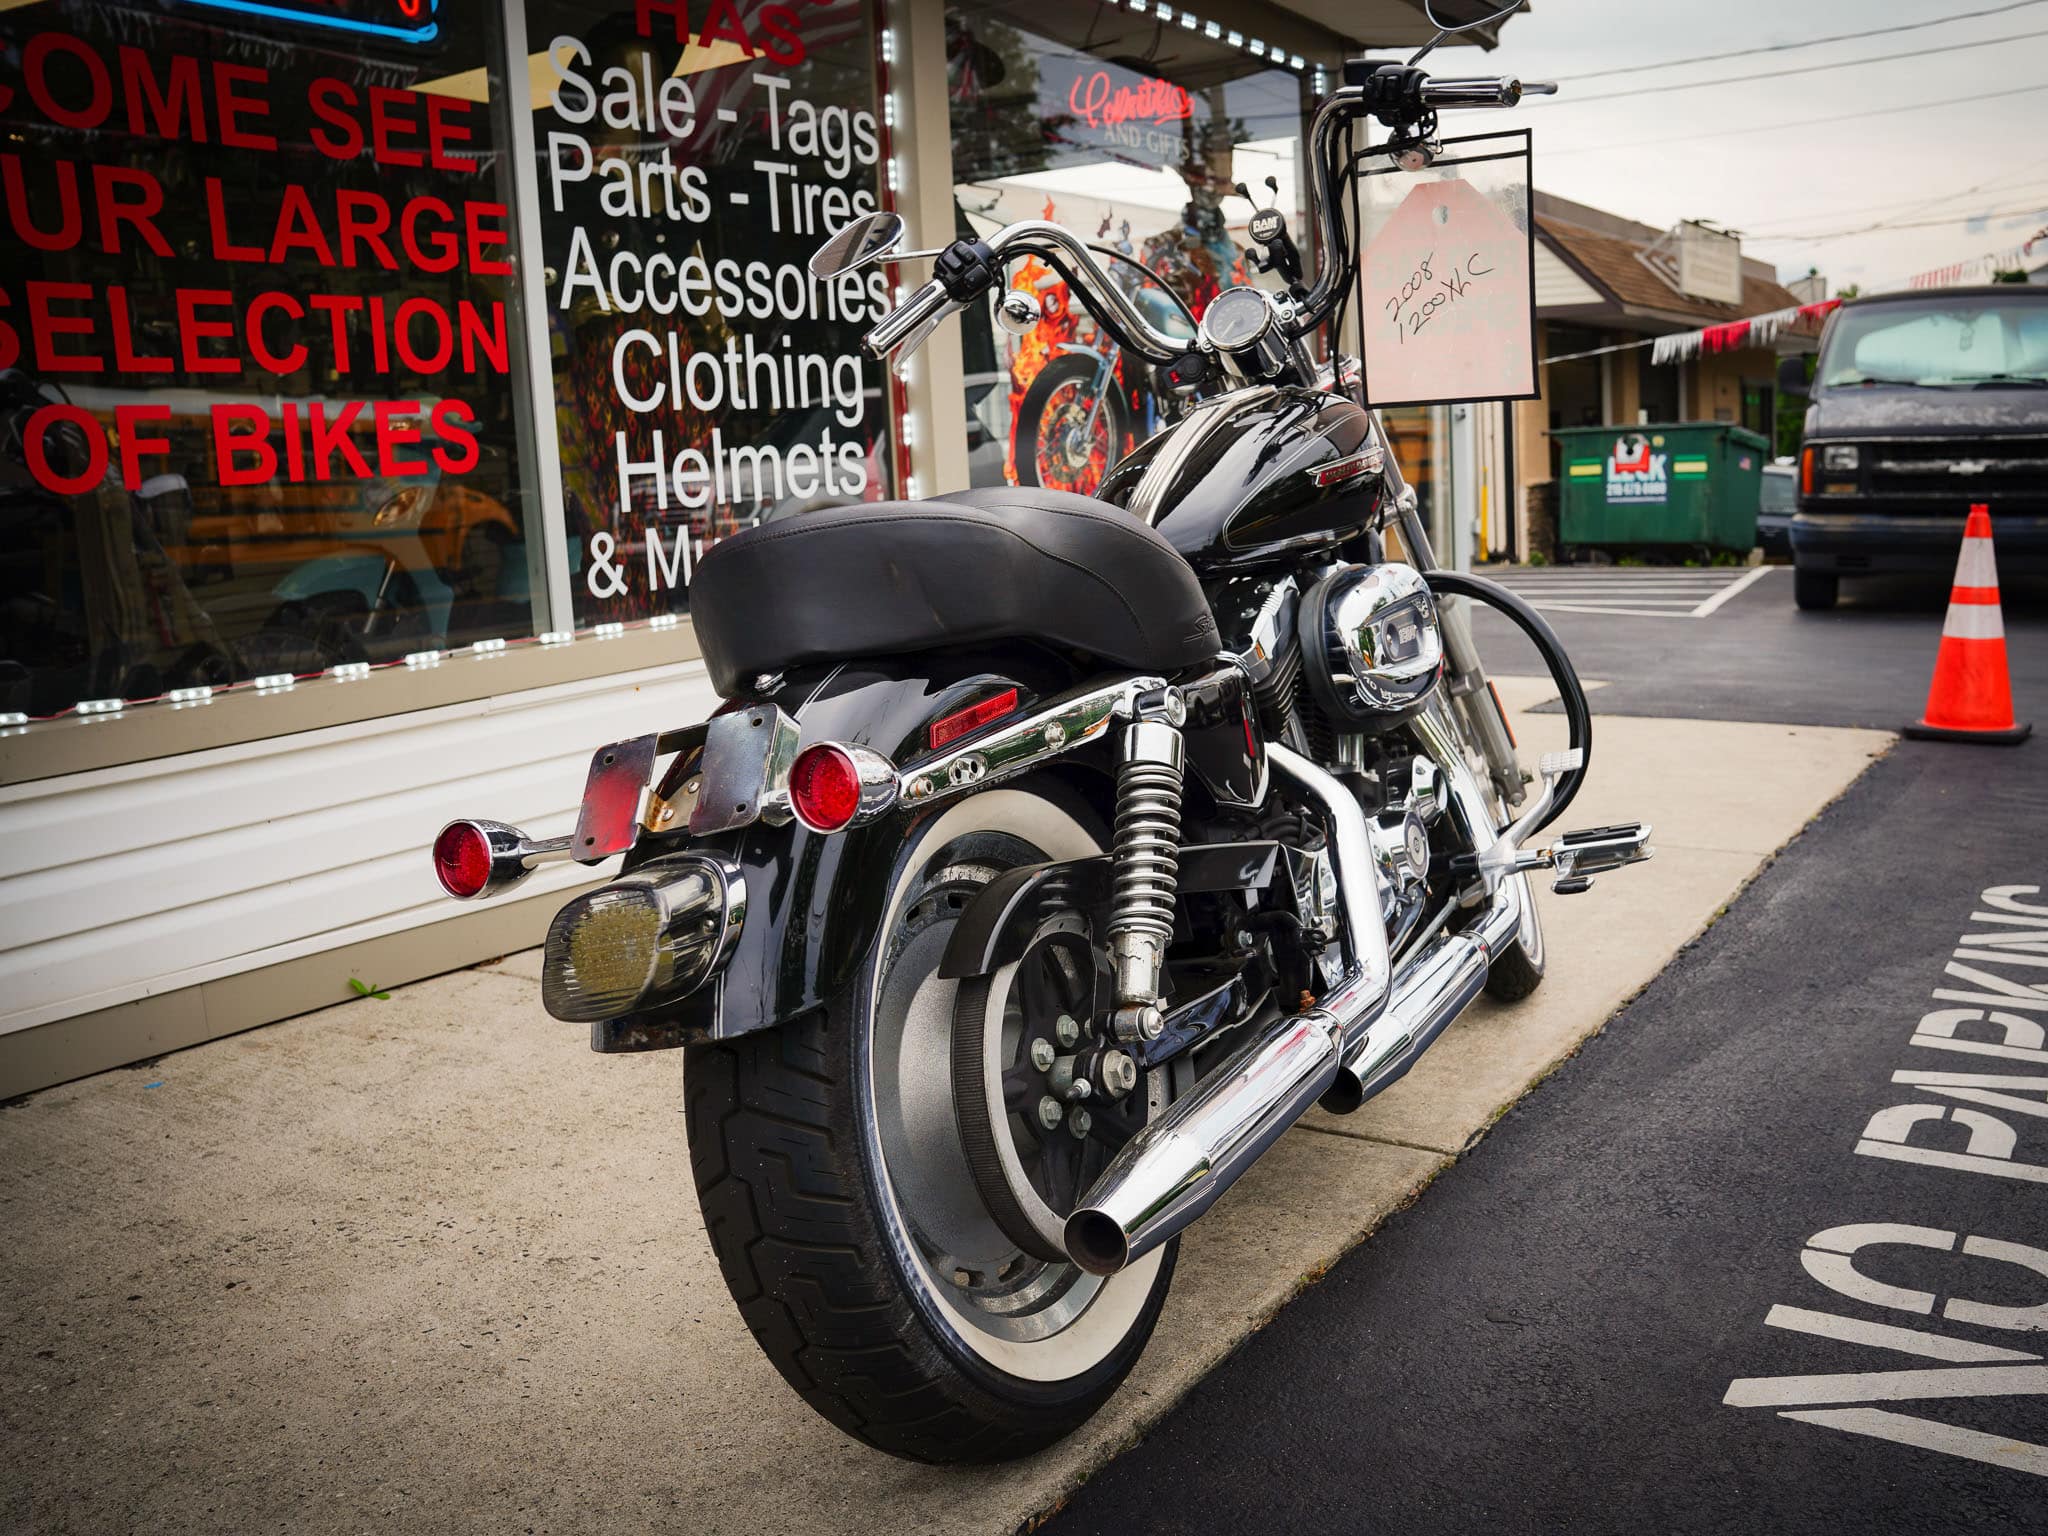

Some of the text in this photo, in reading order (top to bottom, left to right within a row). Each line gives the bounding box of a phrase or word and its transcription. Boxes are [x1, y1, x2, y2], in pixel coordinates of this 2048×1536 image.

[635, 0, 806, 67] HAS
[0, 31, 478, 174] OME SEE
[548, 35, 697, 139] Sale
[752, 73, 880, 181] Tags
[1104, 124, 1191, 161] AND GIFTS
[548, 130, 711, 224] Parts
[205, 176, 513, 276] LARGE
[1386, 251, 1434, 323] 2008
[612, 328, 865, 428] Clothing
[23, 398, 480, 496] OF BIKES
[615, 427, 868, 513] Helmets
[587, 531, 629, 599] &
[1722, 1222, 2048, 1476] NO
